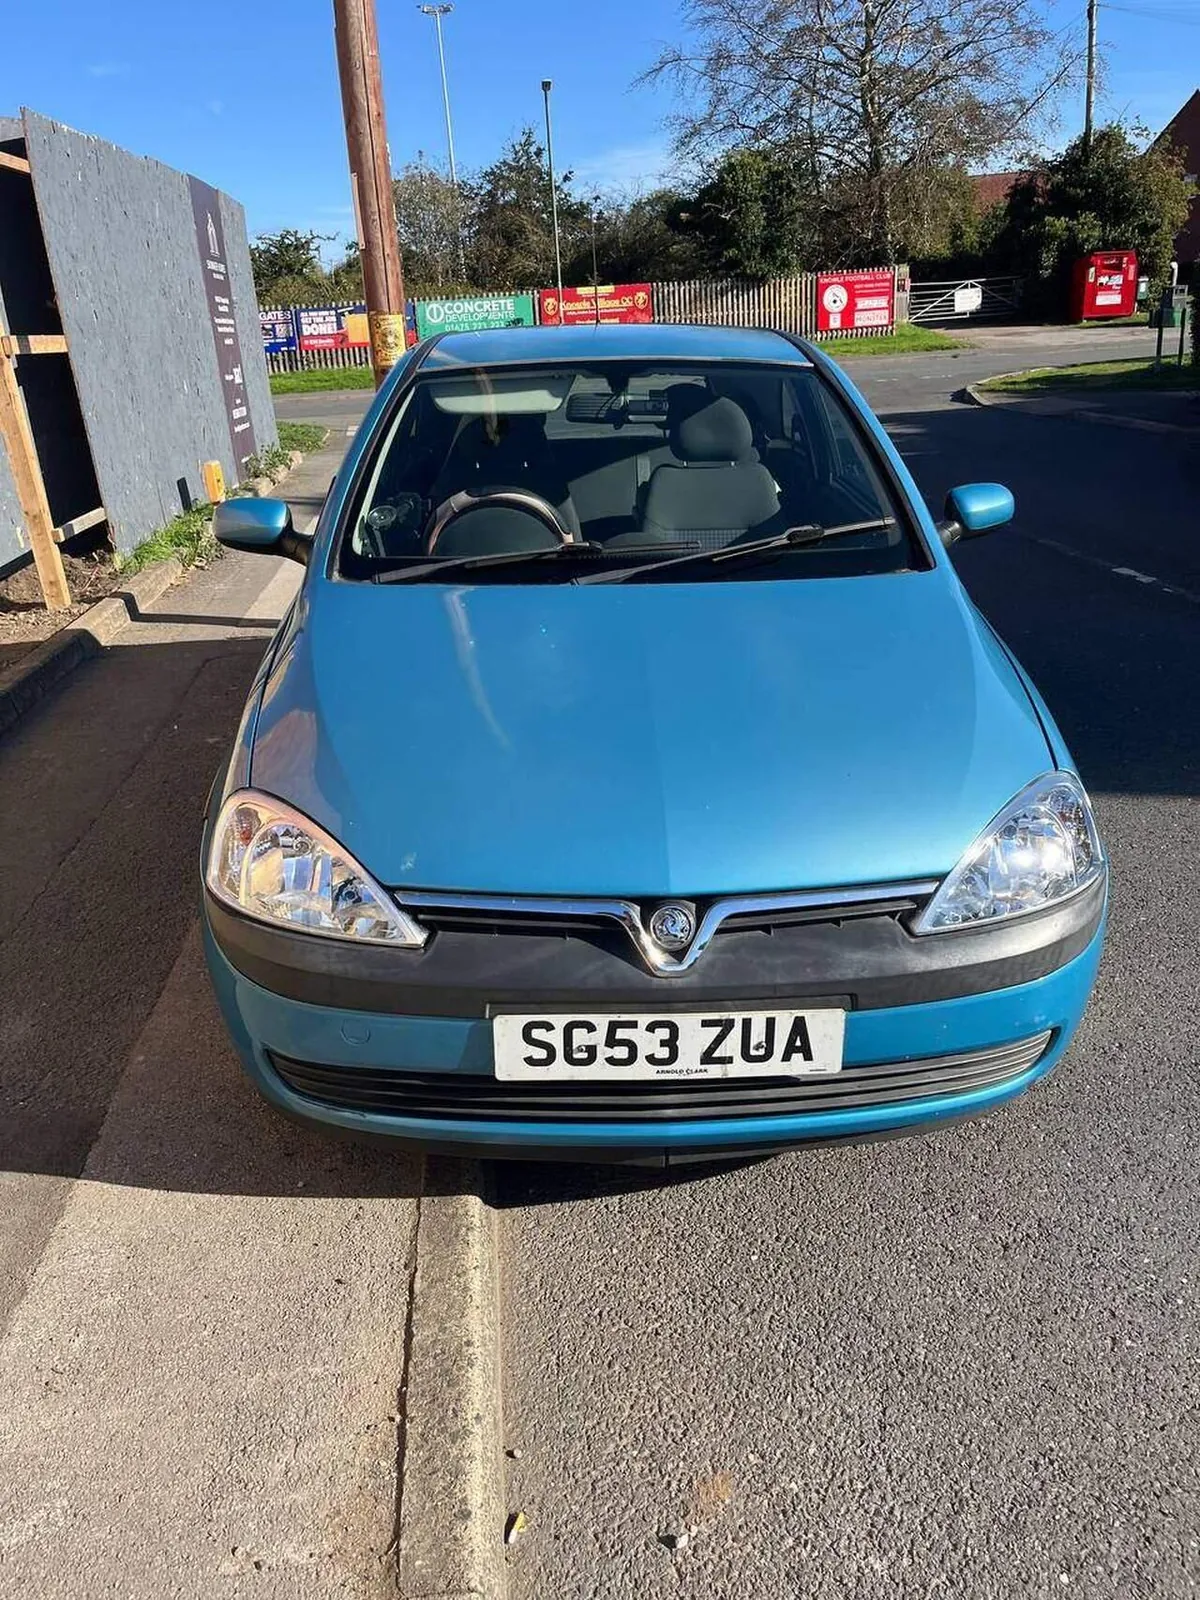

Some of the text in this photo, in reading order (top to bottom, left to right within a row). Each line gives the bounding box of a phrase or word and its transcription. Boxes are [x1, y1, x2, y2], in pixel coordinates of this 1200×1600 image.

[444, 299, 515, 314] CONCRETE
[260, 310, 292, 321] GATES
[445, 310, 515, 323] DEVELOPMENTS
[302, 323, 337, 336] DONE!
[521, 1016, 814, 1067] SG53 ZUA
[686, 1067, 708, 1075] CLARK
